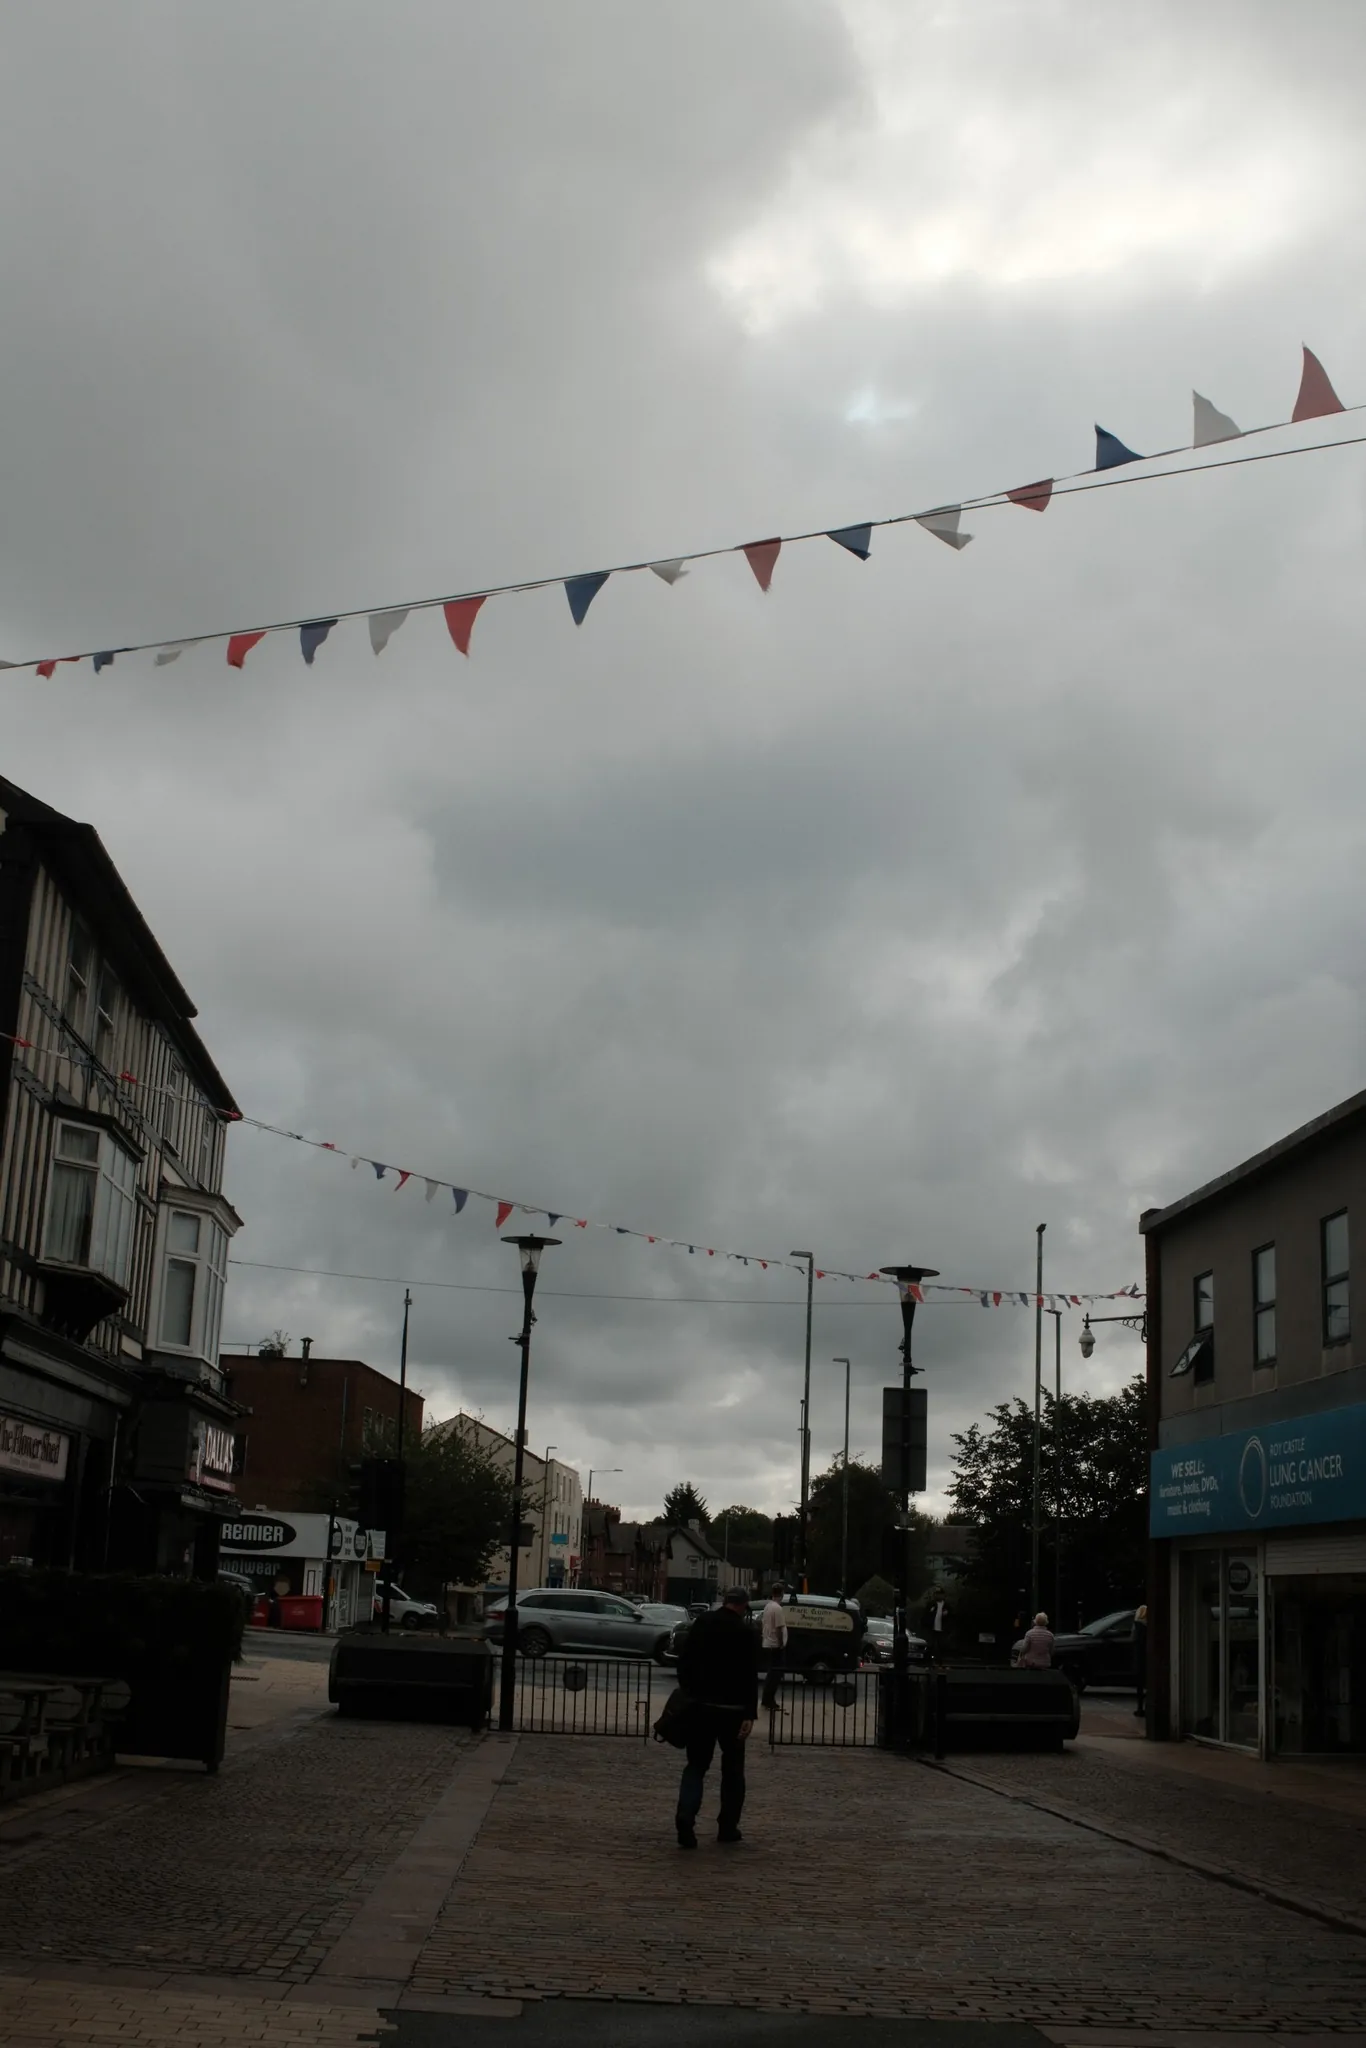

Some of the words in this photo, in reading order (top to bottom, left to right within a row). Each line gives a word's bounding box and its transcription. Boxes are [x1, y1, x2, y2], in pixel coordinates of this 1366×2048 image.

[14, 1424, 42, 1459] Flower
[41, 1432, 61, 1464] Shed
[205, 1424, 235, 1474] DALLAS
[1269, 1443, 1282, 1457] ROY
[1282, 1437, 1305, 1454] CASTLE
[1171, 1462, 1183, 1479] WE
[1184, 1459, 1205, 1476] SELL:
[1269, 1461, 1296, 1487] LUNG
[1298, 1454, 1344, 1482] CANCER
[1270, 1491, 1313, 1509] FOUNDATION
[221, 1522, 284, 1543] REMIER
